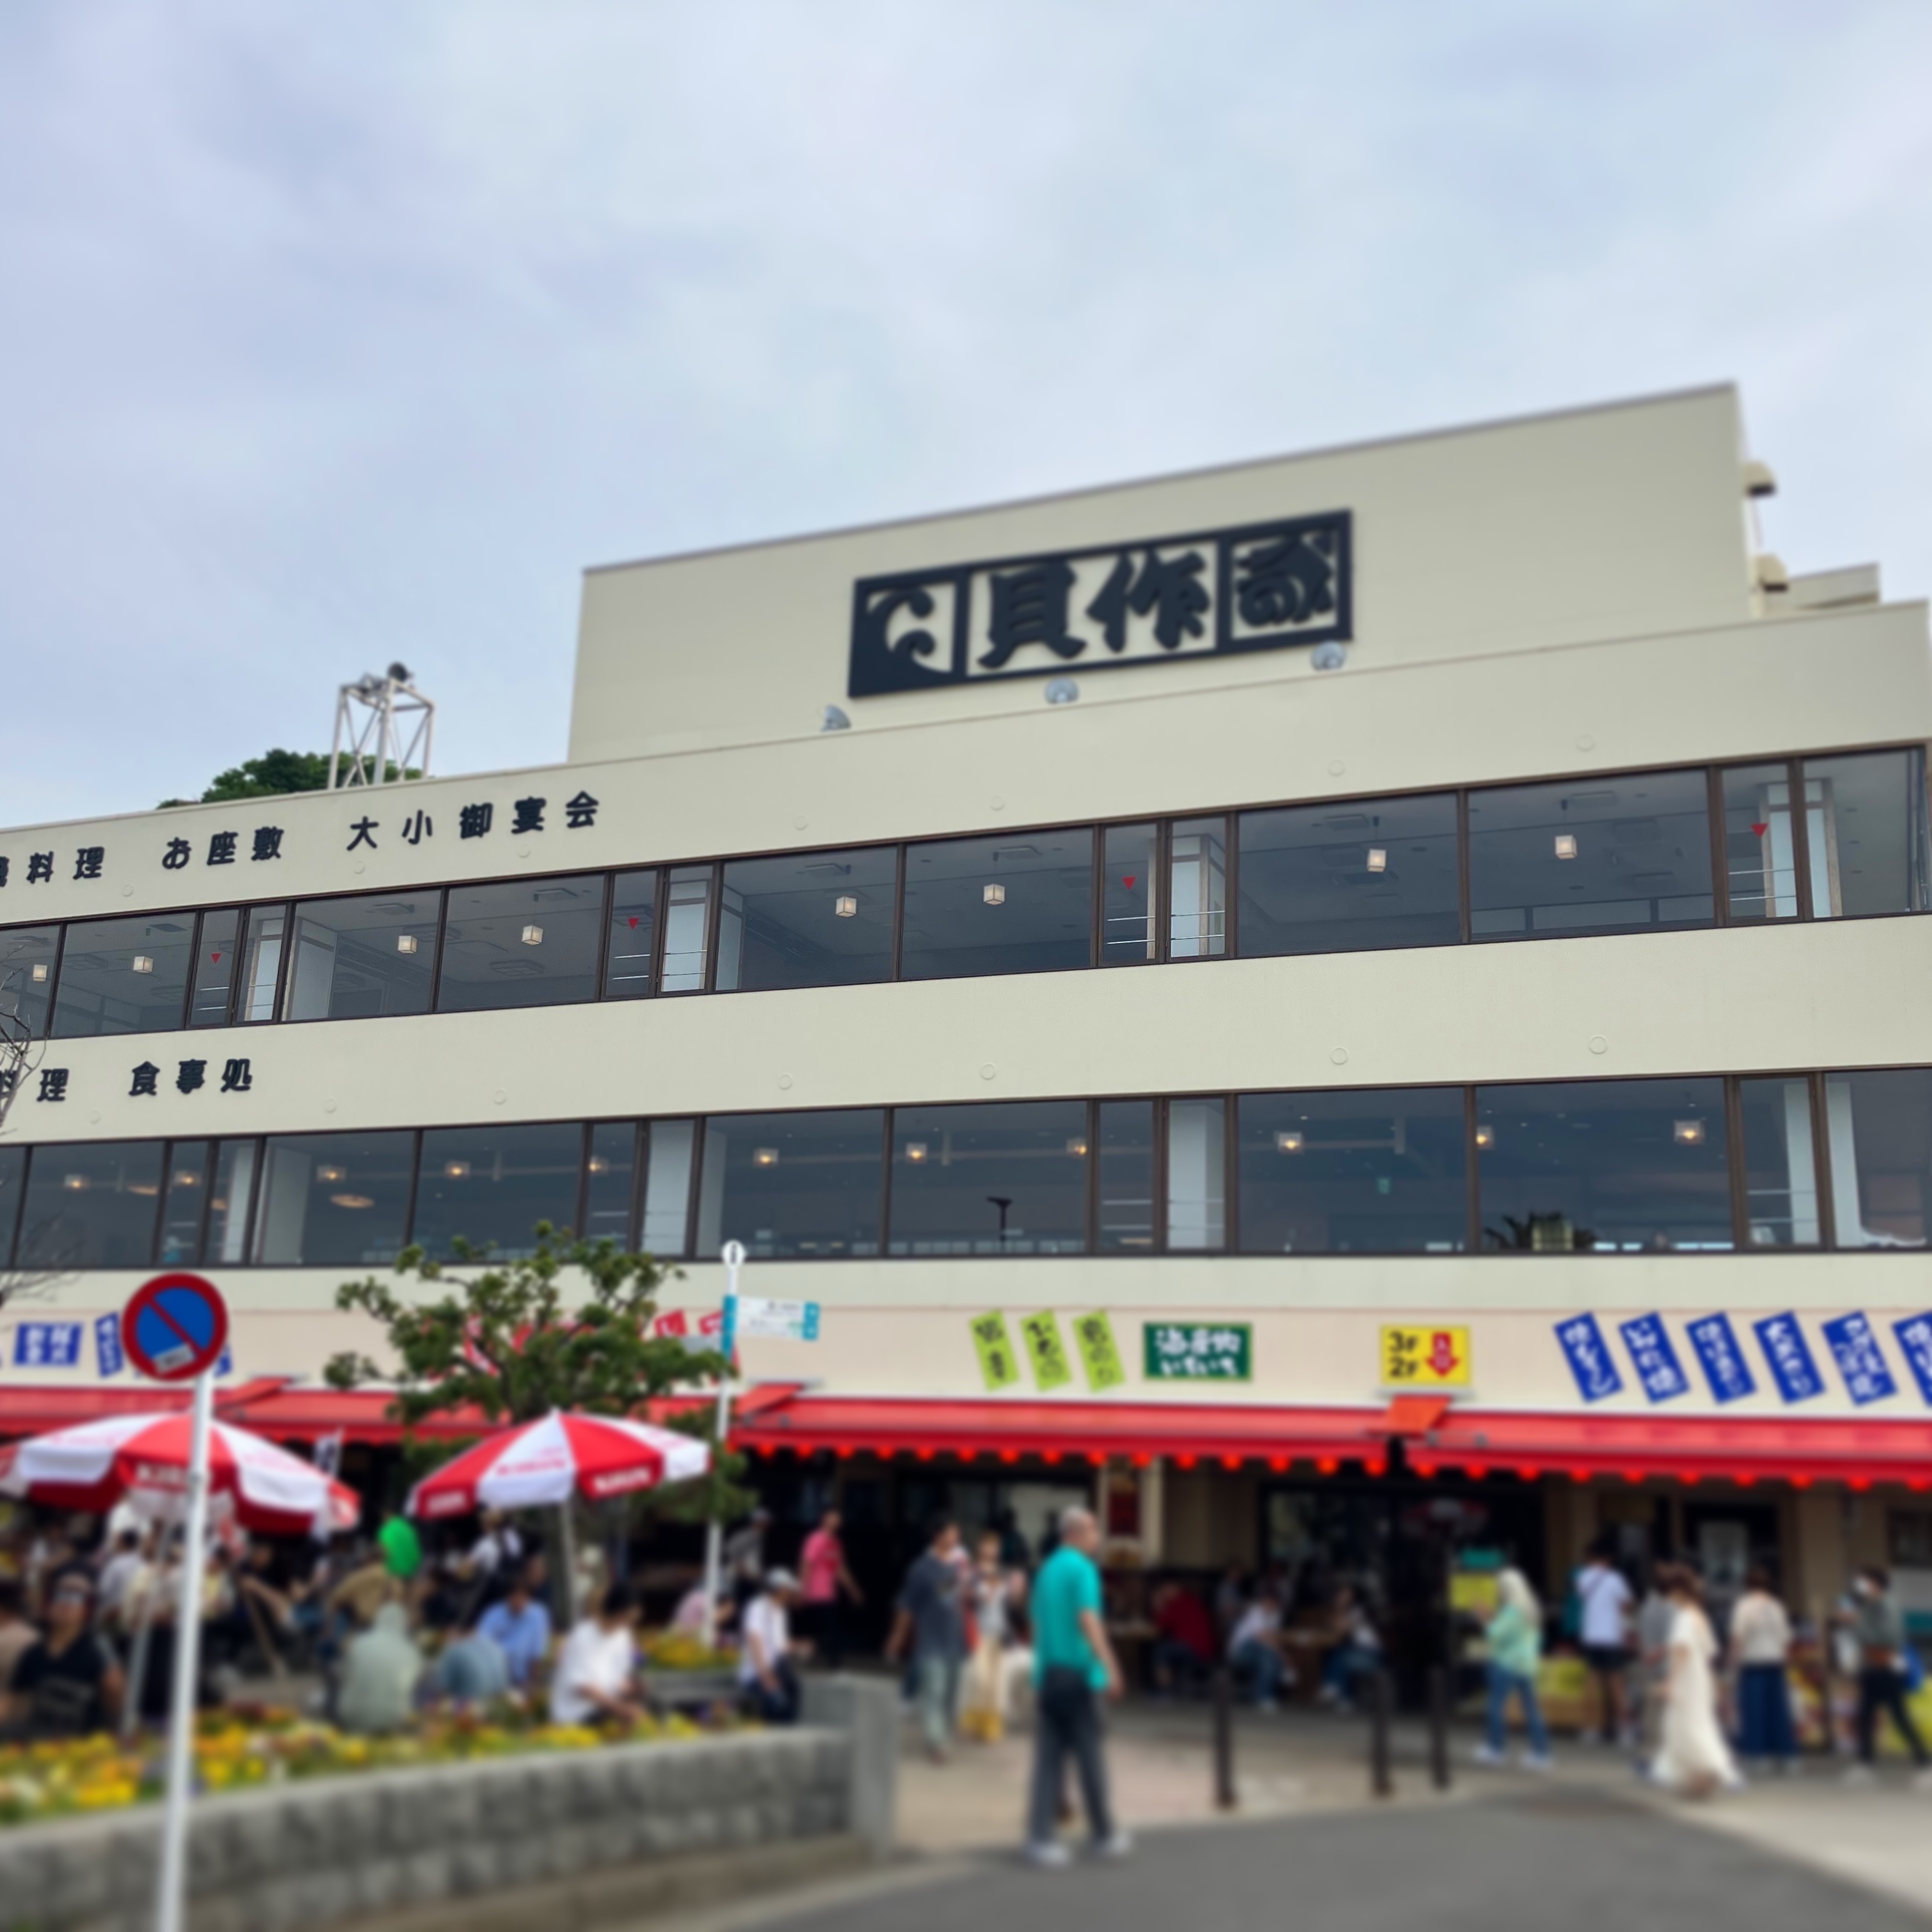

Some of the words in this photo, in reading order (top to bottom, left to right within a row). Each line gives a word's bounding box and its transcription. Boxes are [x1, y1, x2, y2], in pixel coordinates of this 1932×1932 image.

[162, 827, 284, 869] お座敷
[346, 791, 598, 851] 大小御宴会
[129, 1059, 252, 1096] 食事処
